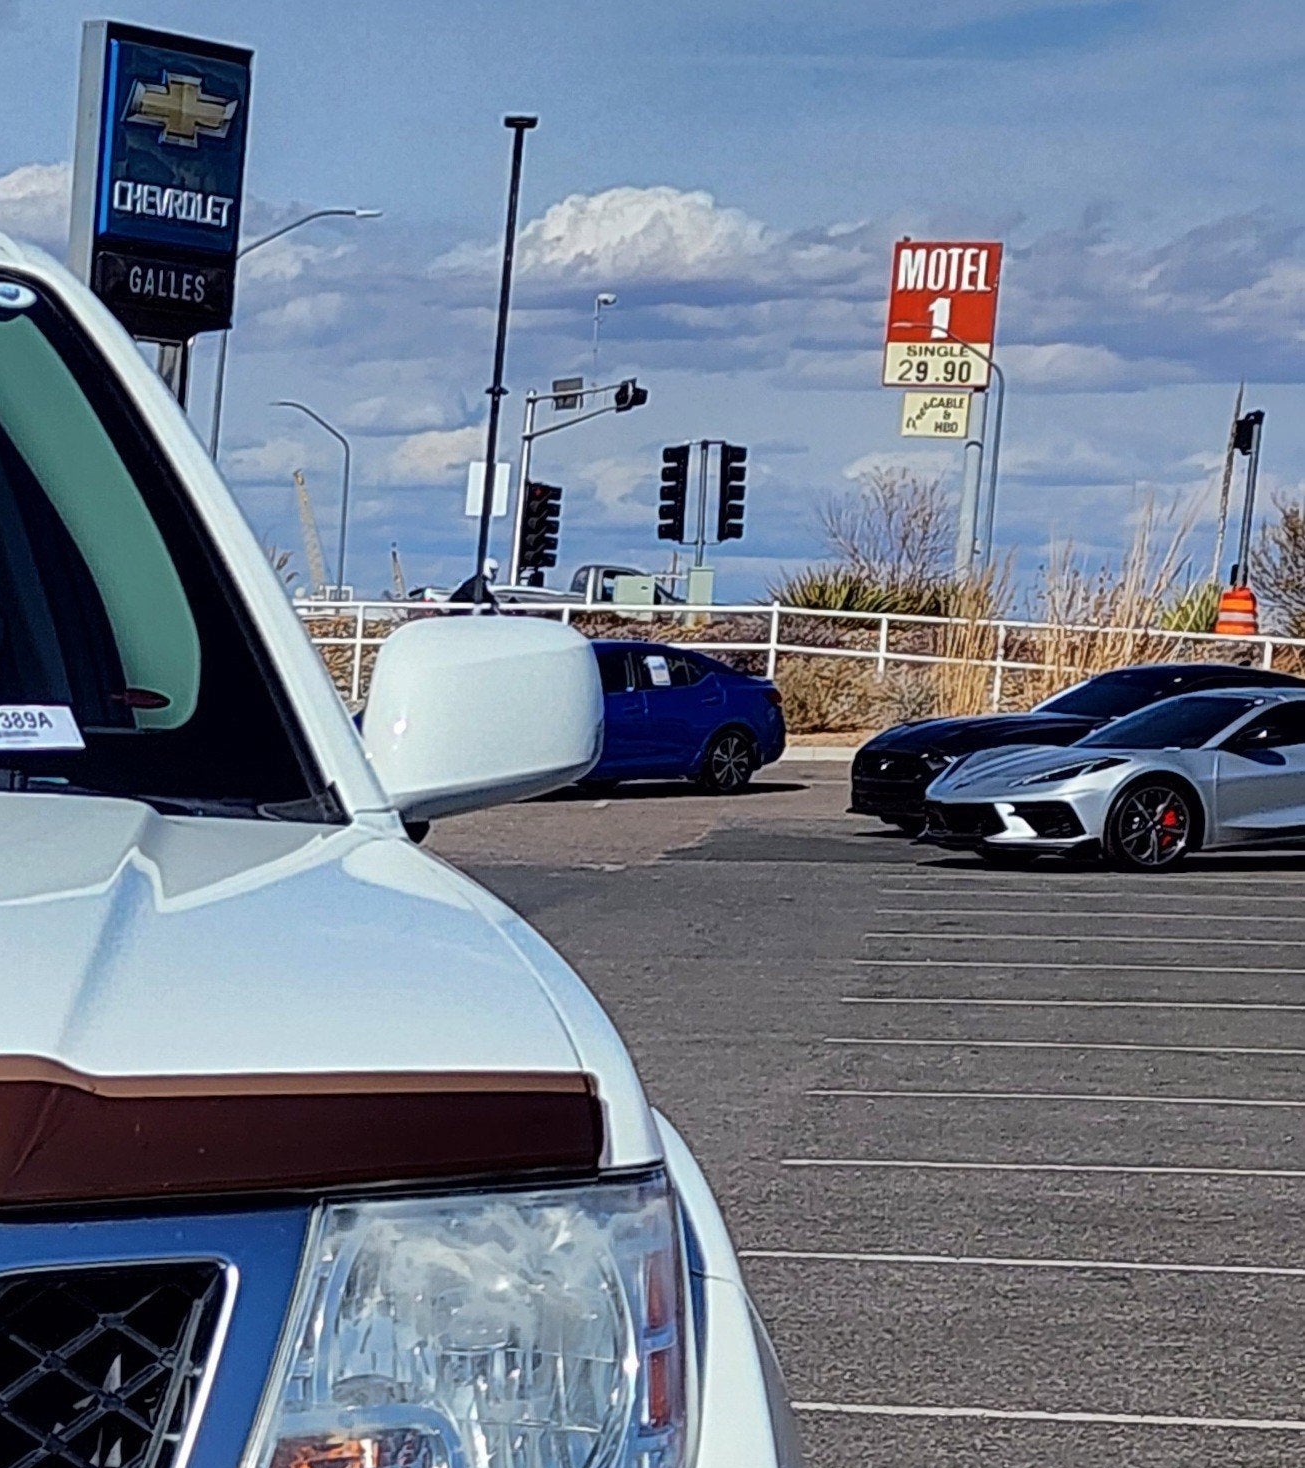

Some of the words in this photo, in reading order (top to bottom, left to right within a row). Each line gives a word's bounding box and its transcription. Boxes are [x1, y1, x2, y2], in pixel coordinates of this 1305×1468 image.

[113, 179, 234, 229] CHEVROLET
[129, 265, 206, 303] GALLES
[897, 247, 992, 292] MOTEL
[928, 296, 952, 339] 1
[906, 345, 970, 357] SINGLE
[898, 359, 972, 383] 29.90
[930, 397, 965, 409] CABLE
